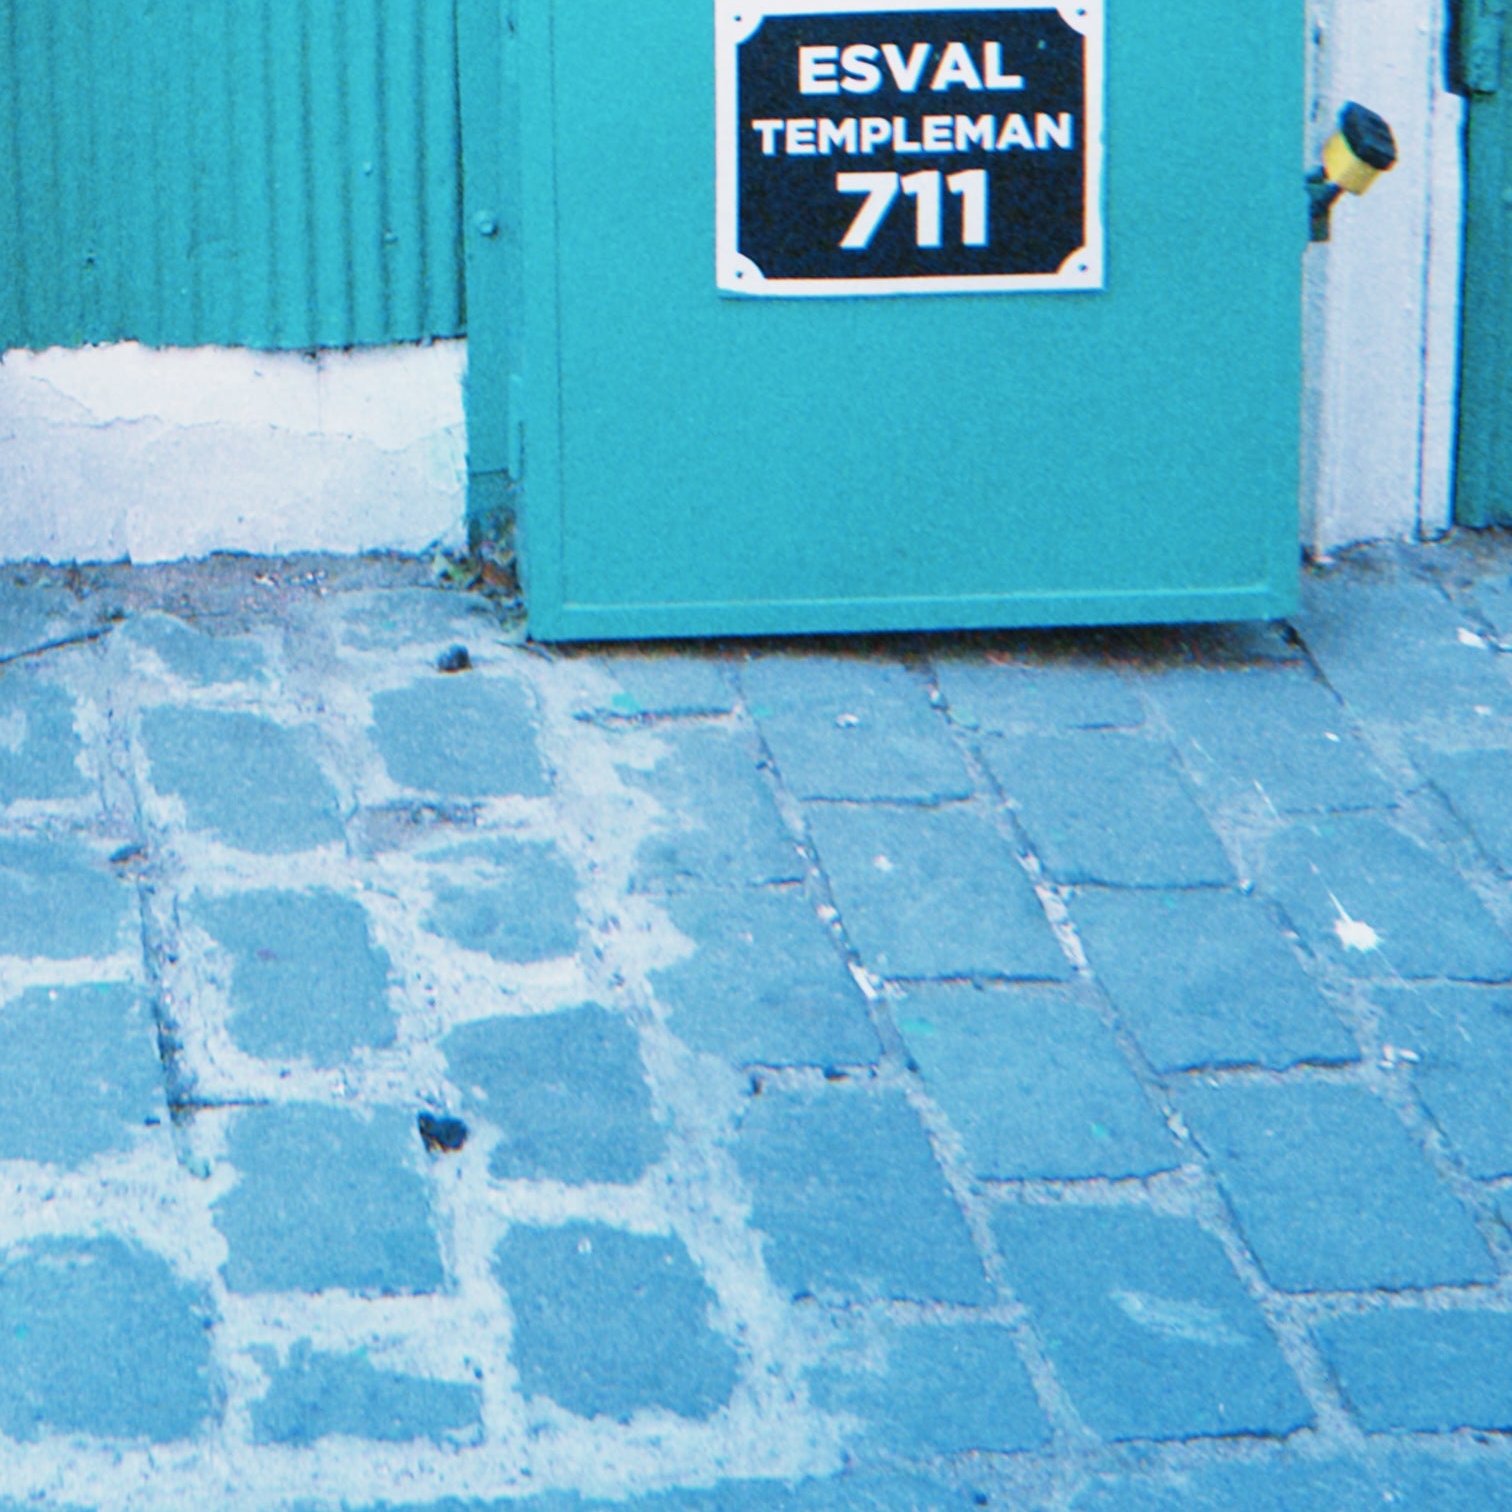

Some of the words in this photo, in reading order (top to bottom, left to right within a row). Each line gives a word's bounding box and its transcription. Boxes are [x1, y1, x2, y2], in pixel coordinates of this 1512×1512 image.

[798, 40, 1024, 95] ESVAL
[751, 111, 1074, 156] TEMPLEMAN
[835, 169, 988, 250] 711
